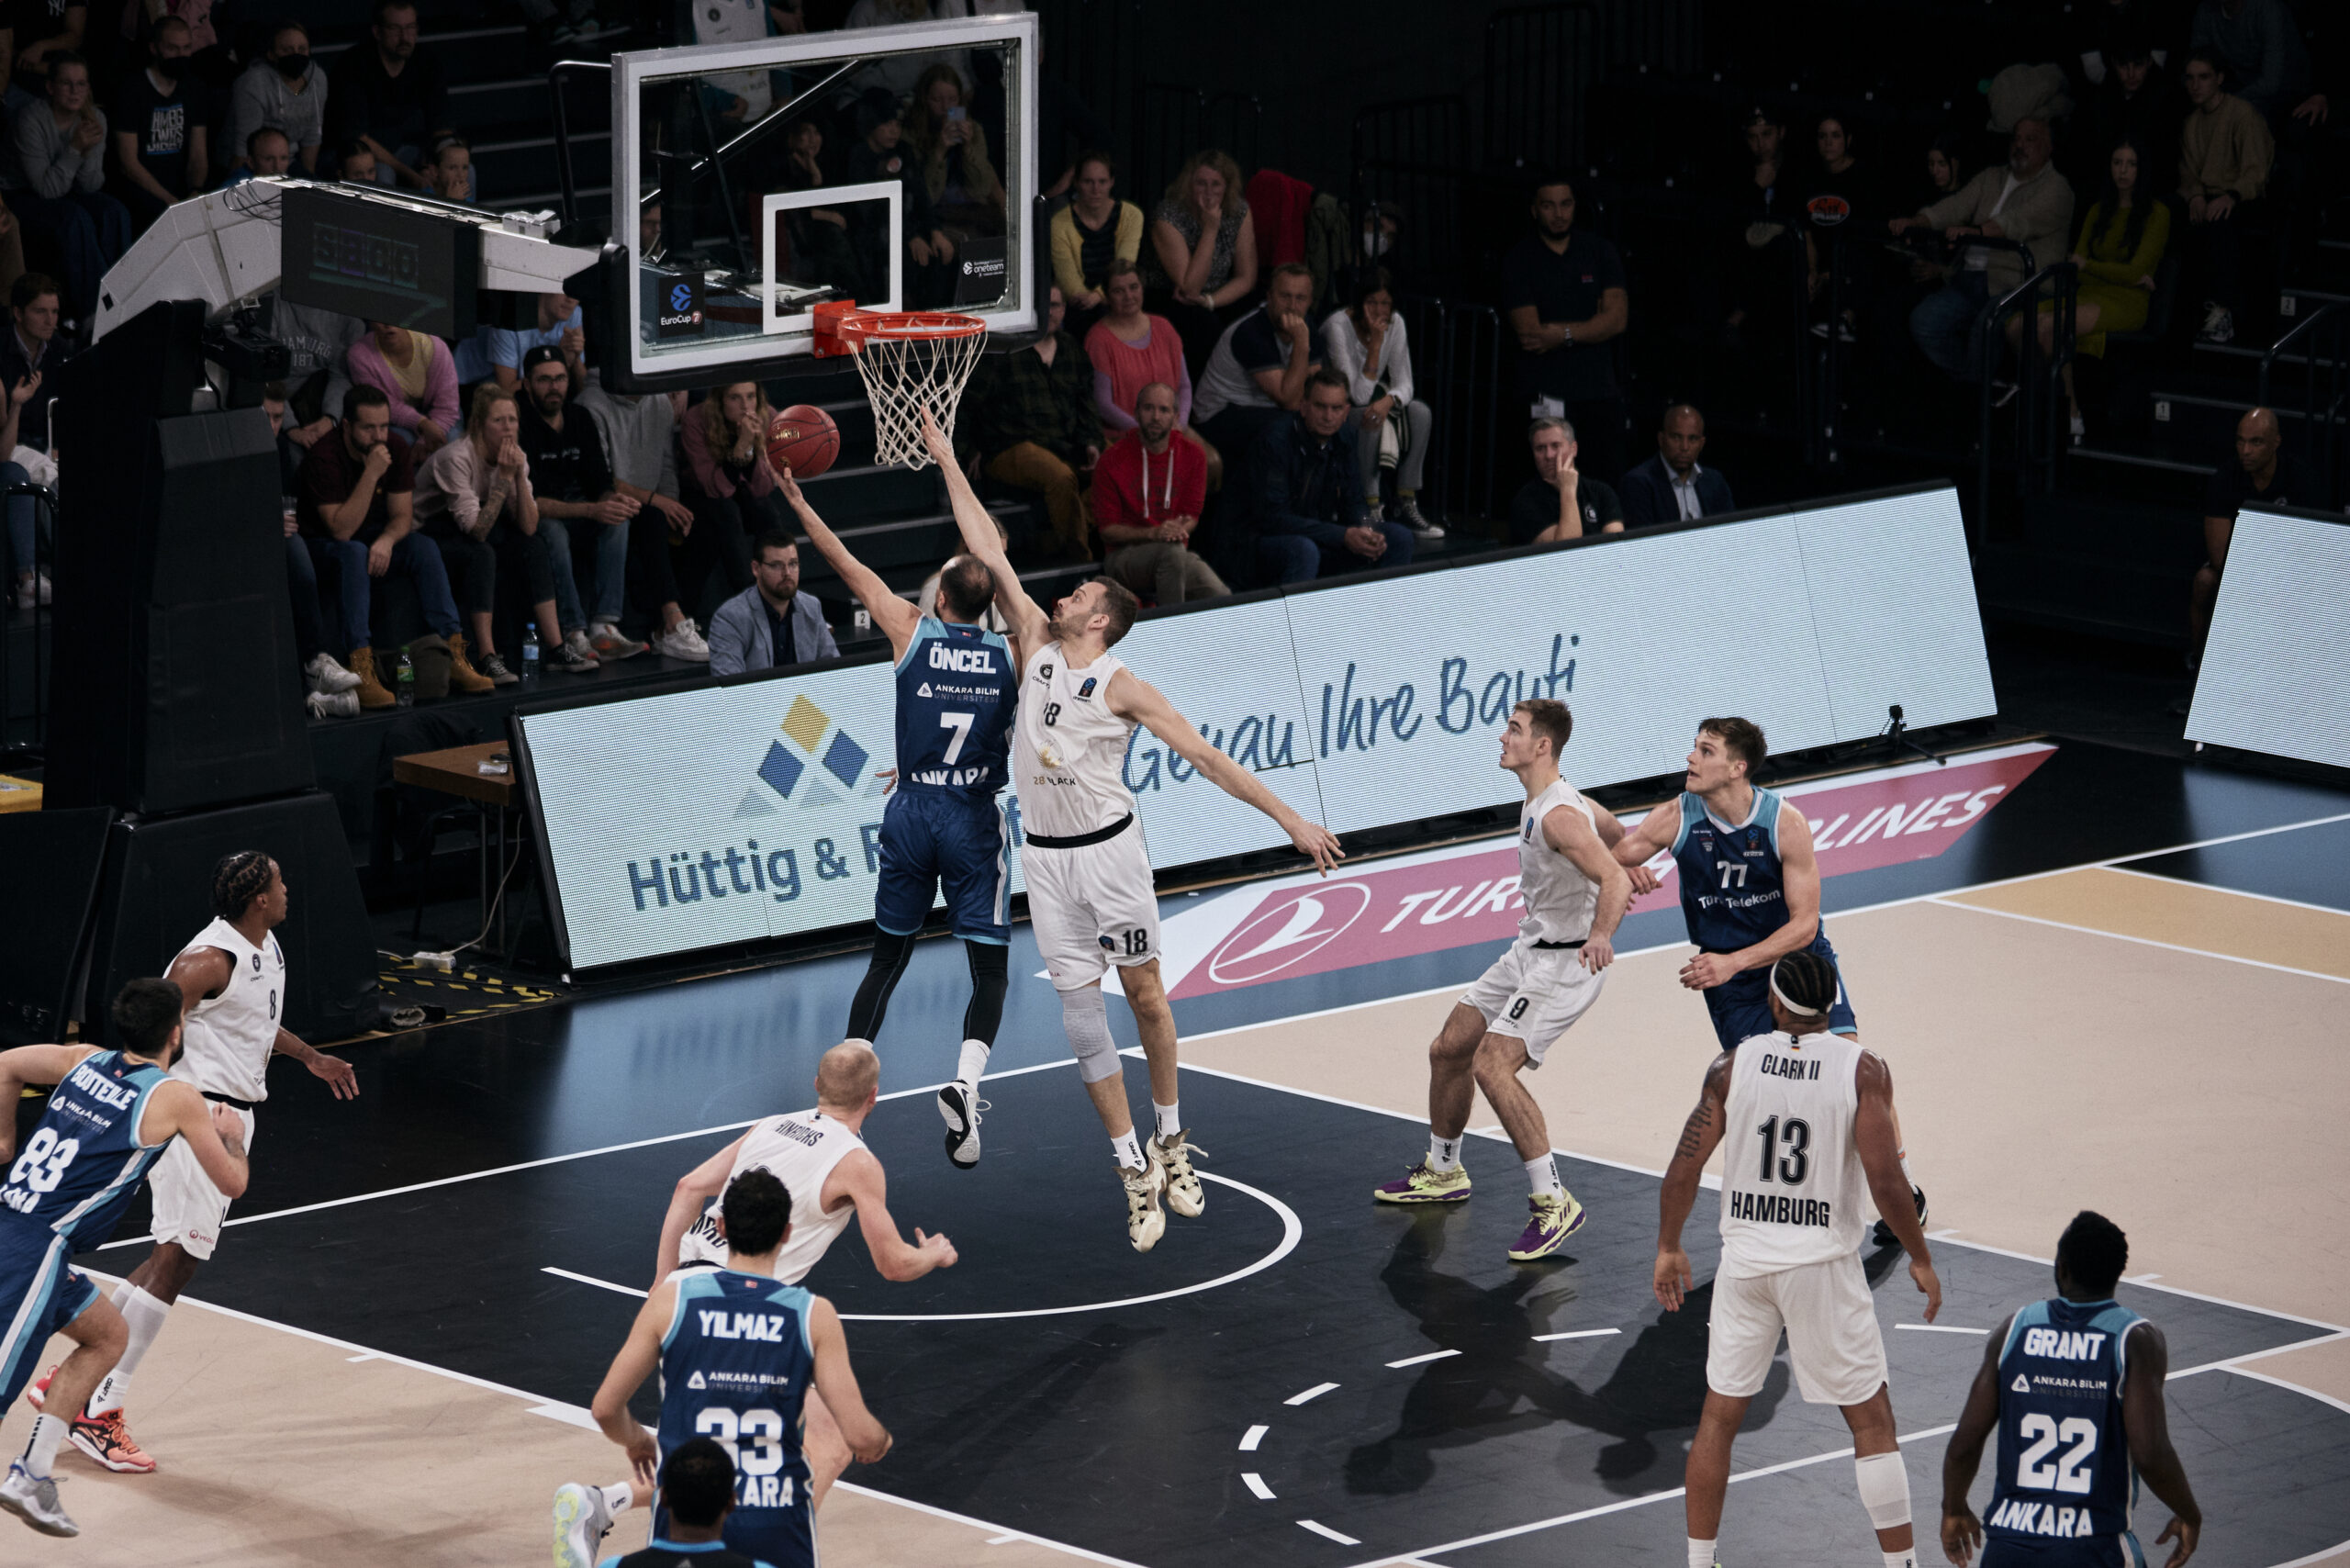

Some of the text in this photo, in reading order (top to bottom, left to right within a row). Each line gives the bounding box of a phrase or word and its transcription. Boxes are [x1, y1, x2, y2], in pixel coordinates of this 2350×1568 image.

[973, 263, 1004, 274] oneteam
[660, 314, 692, 326] EuroCup
[278, 336, 331, 359] AMURG
[294, 353, 314, 367] 187
[929, 641, 997, 675] ÖNCEL
[934, 683, 973, 694] ANKARA
[1319, 660, 1423, 759] Ihre
[940, 711, 976, 766] 7
[1033, 776, 1046, 786] 28
[1808, 785, 2007, 853] LINES
[627, 837, 851, 912] Hüttig &
[1717, 860, 1748, 890] 77
[1698, 890, 1781, 910] Tür Telekom
[1122, 928, 1148, 956] 18
[269, 989, 276, 1020] 8
[1509, 997, 1530, 1020] 9
[1761, 1053, 1821, 1081] CLARK II
[9, 1126, 80, 1193] 83
[1757, 1114, 1811, 1186] 13
[1730, 1190, 1830, 1228] HAMBURG
[698, 1309, 785, 1342] YILMAZ
[2023, 1327, 2107, 1361] GRANT
[709, 1371, 757, 1383] ANKARA
[2032, 1375, 2077, 1388] ANKARA
[696, 1406, 784, 1476] 33
[2017, 1412, 2098, 1495] 22
[735, 1475, 794, 1507] KARA
[1989, 1498, 2094, 1538] ANKARA
